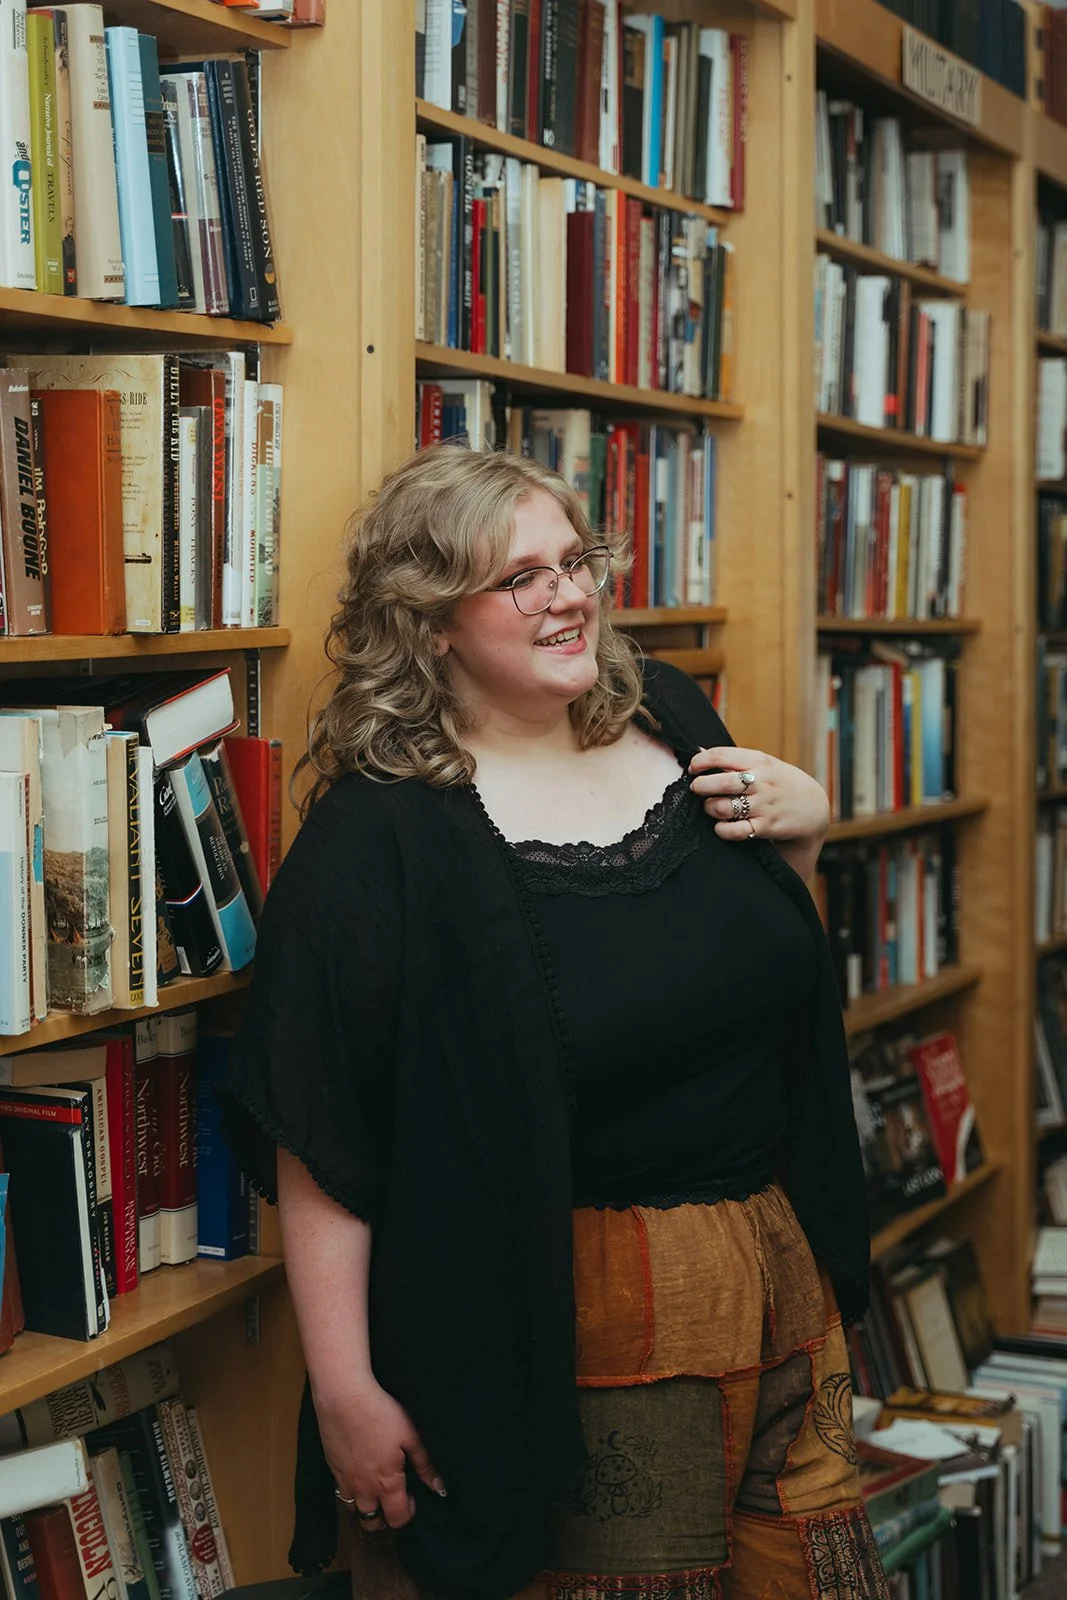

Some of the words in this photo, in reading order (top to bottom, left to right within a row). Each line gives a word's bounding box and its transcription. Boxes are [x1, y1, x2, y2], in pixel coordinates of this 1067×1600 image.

[44, 93, 53, 128] Narrative
[15, 140, 31, 161] and
[45, 129, 54, 156] Journal
[247, 109, 262, 168] GOD'S
[47, 172, 56, 223] TRAVELS
[254, 175, 265, 213] RED
[260, 219, 272, 259] SON
[130, 391, 148, 405] RIDE
[170, 366, 180, 407] BILLY
[170, 412, 180, 435] THE
[214, 398, 225, 444] OWN
[14, 416, 35, 497] DANIEL
[170, 436, 180, 461] KID
[214, 450, 225, 505] WEST
[20, 502, 41, 582] BOONE
[128, 767, 143, 882] VALIANT
[130, 896, 144, 987] SEVEN
[13, 1106, 41, 1115] ORIGINAL
[42, 1109, 57, 1117] FILM
[82, 1104, 91, 1134] RAY
[95, 1087, 105, 1135] AMERICAN
[136, 1077, 150, 1177] Northwest
[179, 1069, 190, 1169] Northwest
[85, 1140, 97, 1218] BRADBURY
[98, 1138, 108, 1187] GOSPEL
[152, 1421, 165, 1454] BRIAN
[159, 1455, 177, 1504] KILMEADE
[70, 1472, 114, 1580] INCOLN
